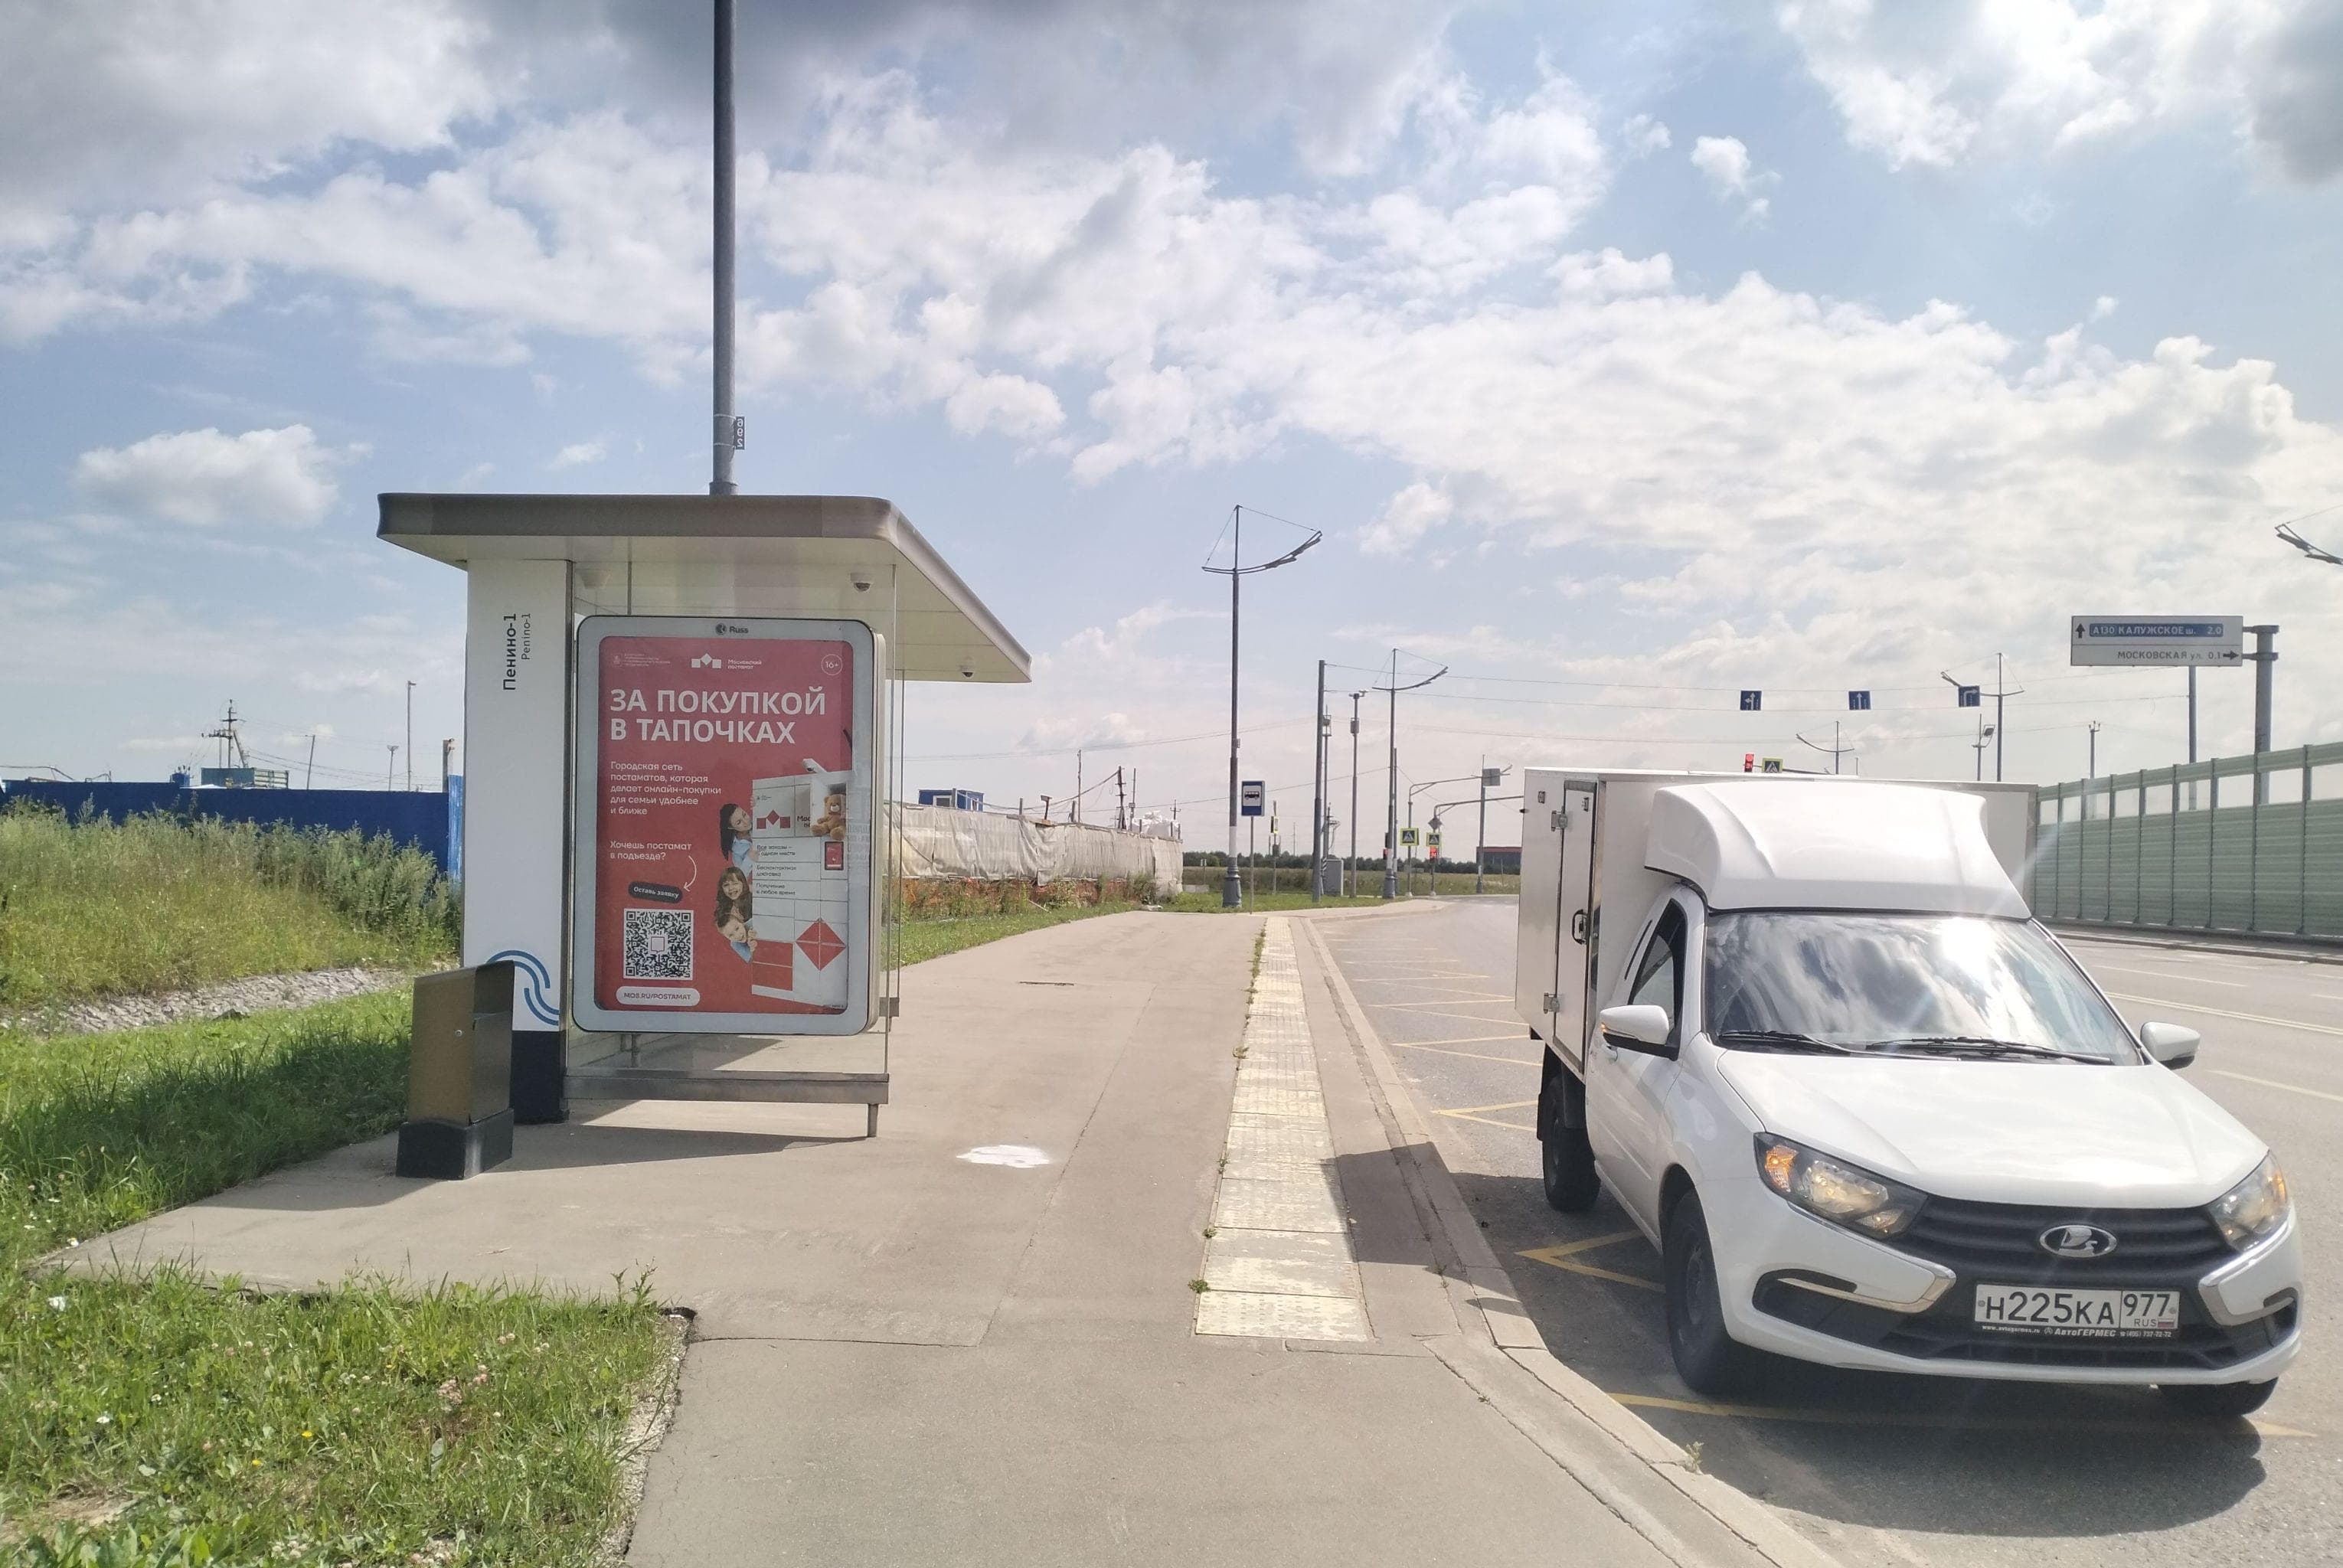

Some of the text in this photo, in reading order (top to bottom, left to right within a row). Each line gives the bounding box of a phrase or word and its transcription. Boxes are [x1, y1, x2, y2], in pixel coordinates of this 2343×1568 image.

[729, 626, 749, 634] Russ
[2118, 626, 2185, 635] КАЛУЖСКОЕ
[2207, 626, 2222, 635] 2.0
[521, 612, 531, 660] Penino-1
[503, 613, 516, 691] Пенино-1
[2118, 652, 2188, 660] МОСКОВСКАЯ
[825, 660, 839, 668] 16+
[610, 686, 825, 715] ЗА ПОКУПКОЙ
[610, 719, 796, 744] В ТАПОЧКАХ
[610, 761, 659, 771] Городская
[610, 774, 668, 783] постаматов,
[644, 785, 722, 795] онлайн-покупки
[658, 796, 699, 805] удобнее
[618, 806, 648, 815] ближе
[610, 841, 645, 849] Хочешь
[633, 886, 656, 895] Оставь
[624, 992, 692, 1001] MOS.RU/POSTAMAT
[1985, 1291, 2171, 1325] Н225КА 977
[2134, 1318, 2157, 1328] RUS
[2054, 1327, 2116, 1338] АвтоГЕРМЕС
